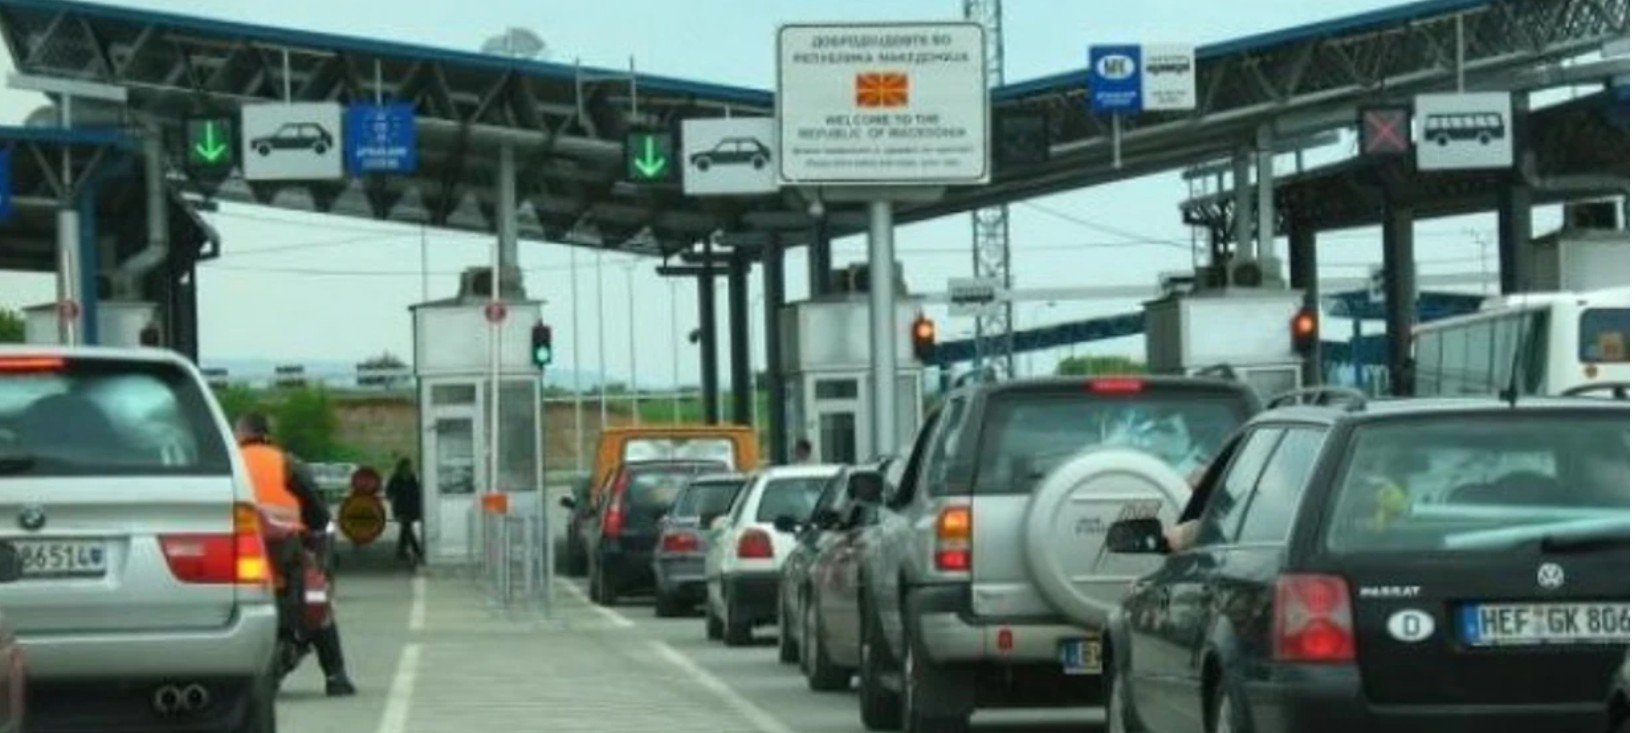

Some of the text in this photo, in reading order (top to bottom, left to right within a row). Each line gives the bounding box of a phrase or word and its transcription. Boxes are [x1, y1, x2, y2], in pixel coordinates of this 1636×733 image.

[826, 114, 940, 125] WELCOME TO THE
[798, 127, 967, 138] REPUBLIC OF MACEDONIA
[1403, 614, 1420, 636] D
[1481, 607, 1530, 634] HEF
[1547, 607, 1579, 634] GK
